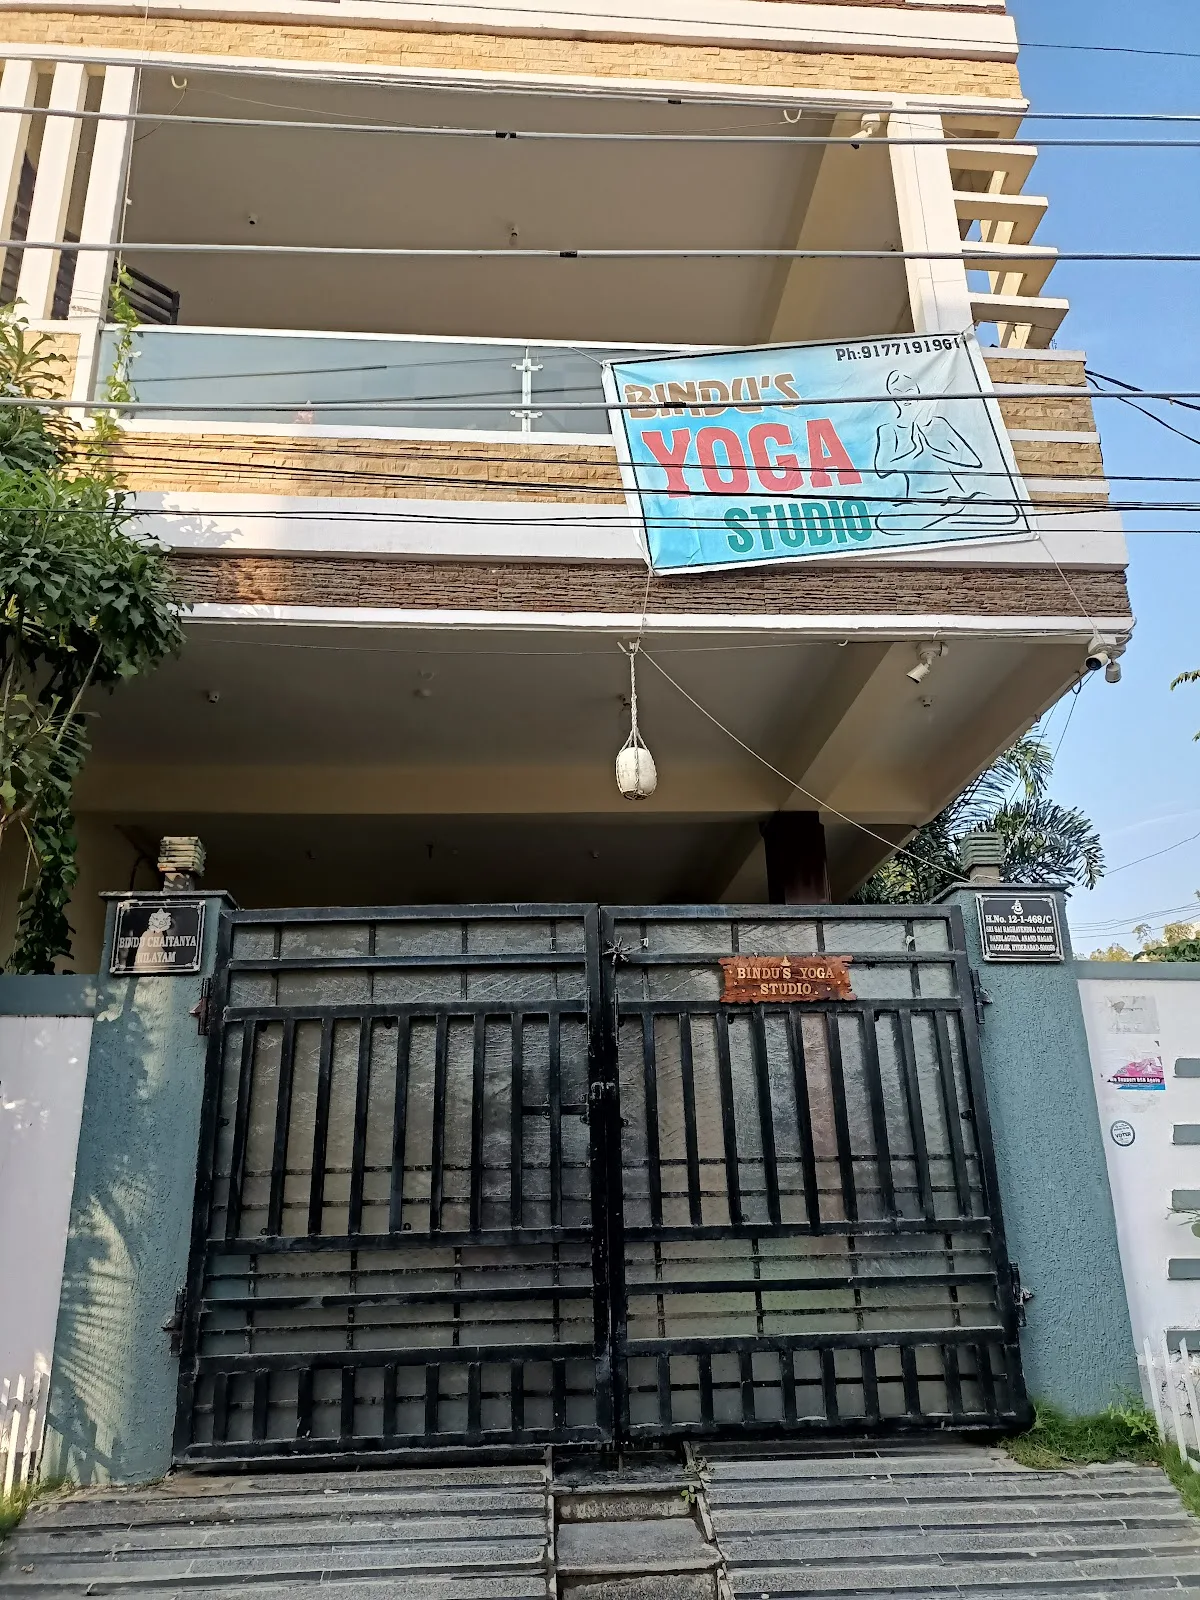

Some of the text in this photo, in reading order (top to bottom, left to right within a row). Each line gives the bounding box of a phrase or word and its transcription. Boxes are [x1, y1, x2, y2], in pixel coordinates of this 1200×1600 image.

[623, 373, 800, 419] BINDU'S
[640, 417, 863, 499] YOGA
[723, 499, 874, 554] STUDIO
[148, 936, 197, 947] CHAITANYA
[137, 952, 176, 963] NILAYAM
[737, 967, 835, 979] BINDU'S YOGA
[760, 983, 812, 995] STUDIO
